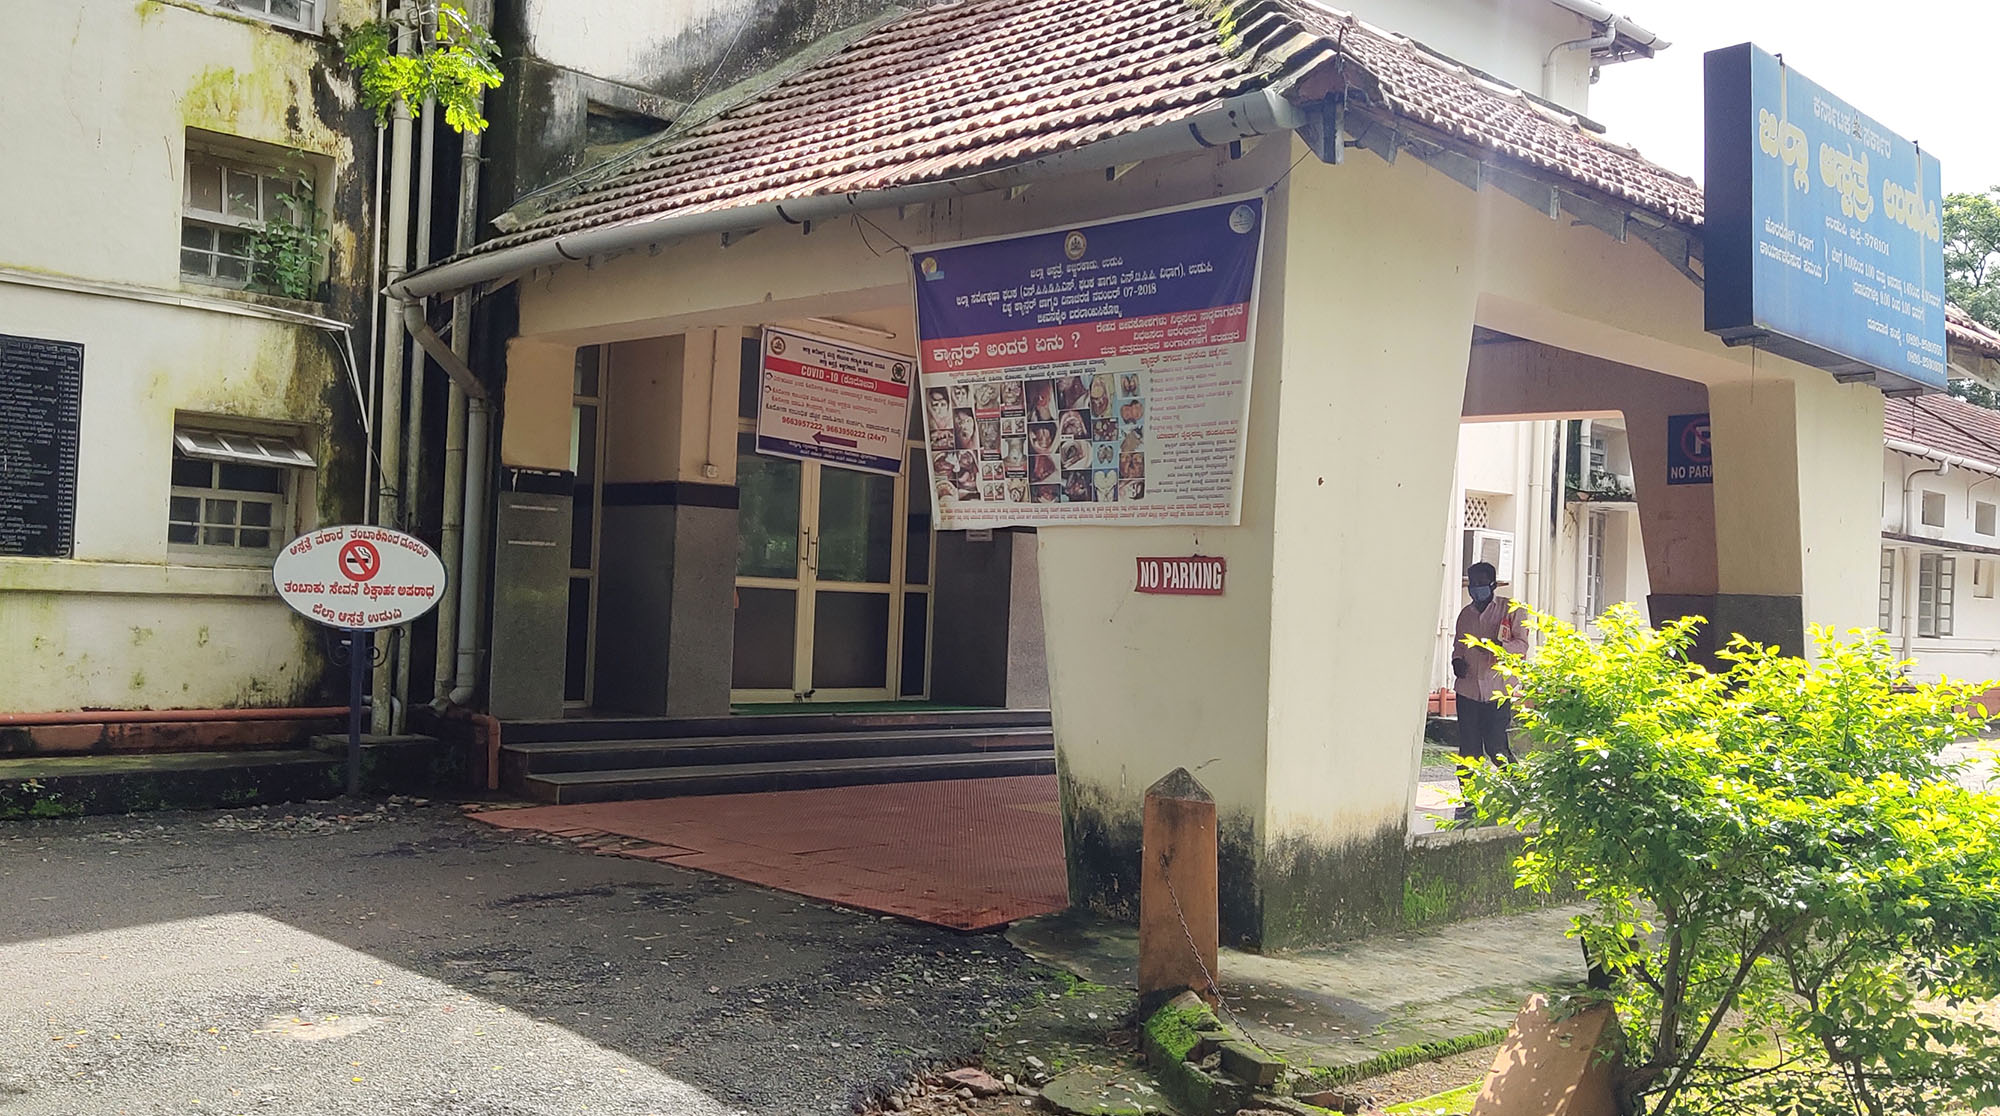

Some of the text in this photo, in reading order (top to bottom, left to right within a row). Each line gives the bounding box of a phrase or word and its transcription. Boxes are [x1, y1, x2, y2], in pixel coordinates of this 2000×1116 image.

[1759, 108, 1810, 194] ಜಿಲ್ಲಾ
[1883, 178, 1940, 243] ಉಡುಪಿ
[1123, 282, 1157, 298] 07-2018
[933, 341, 980, 368] ಕ್ಯಾನ್ಸರ್
[986, 336, 1028, 357] ಅಂದರೆ
[1035, 333, 1065, 352] ಏನು
[801, 364, 825, 381] COVID
[1671, 466, 1686, 479] NO
[1140, 561, 1222, 590] NO PARKING
[284, 580, 325, 594] ತಂಬಾಕು
[329, 581, 359, 596] ಸೇವನೆ
[397, 584, 435, 600] ಅಪರಾಧ
